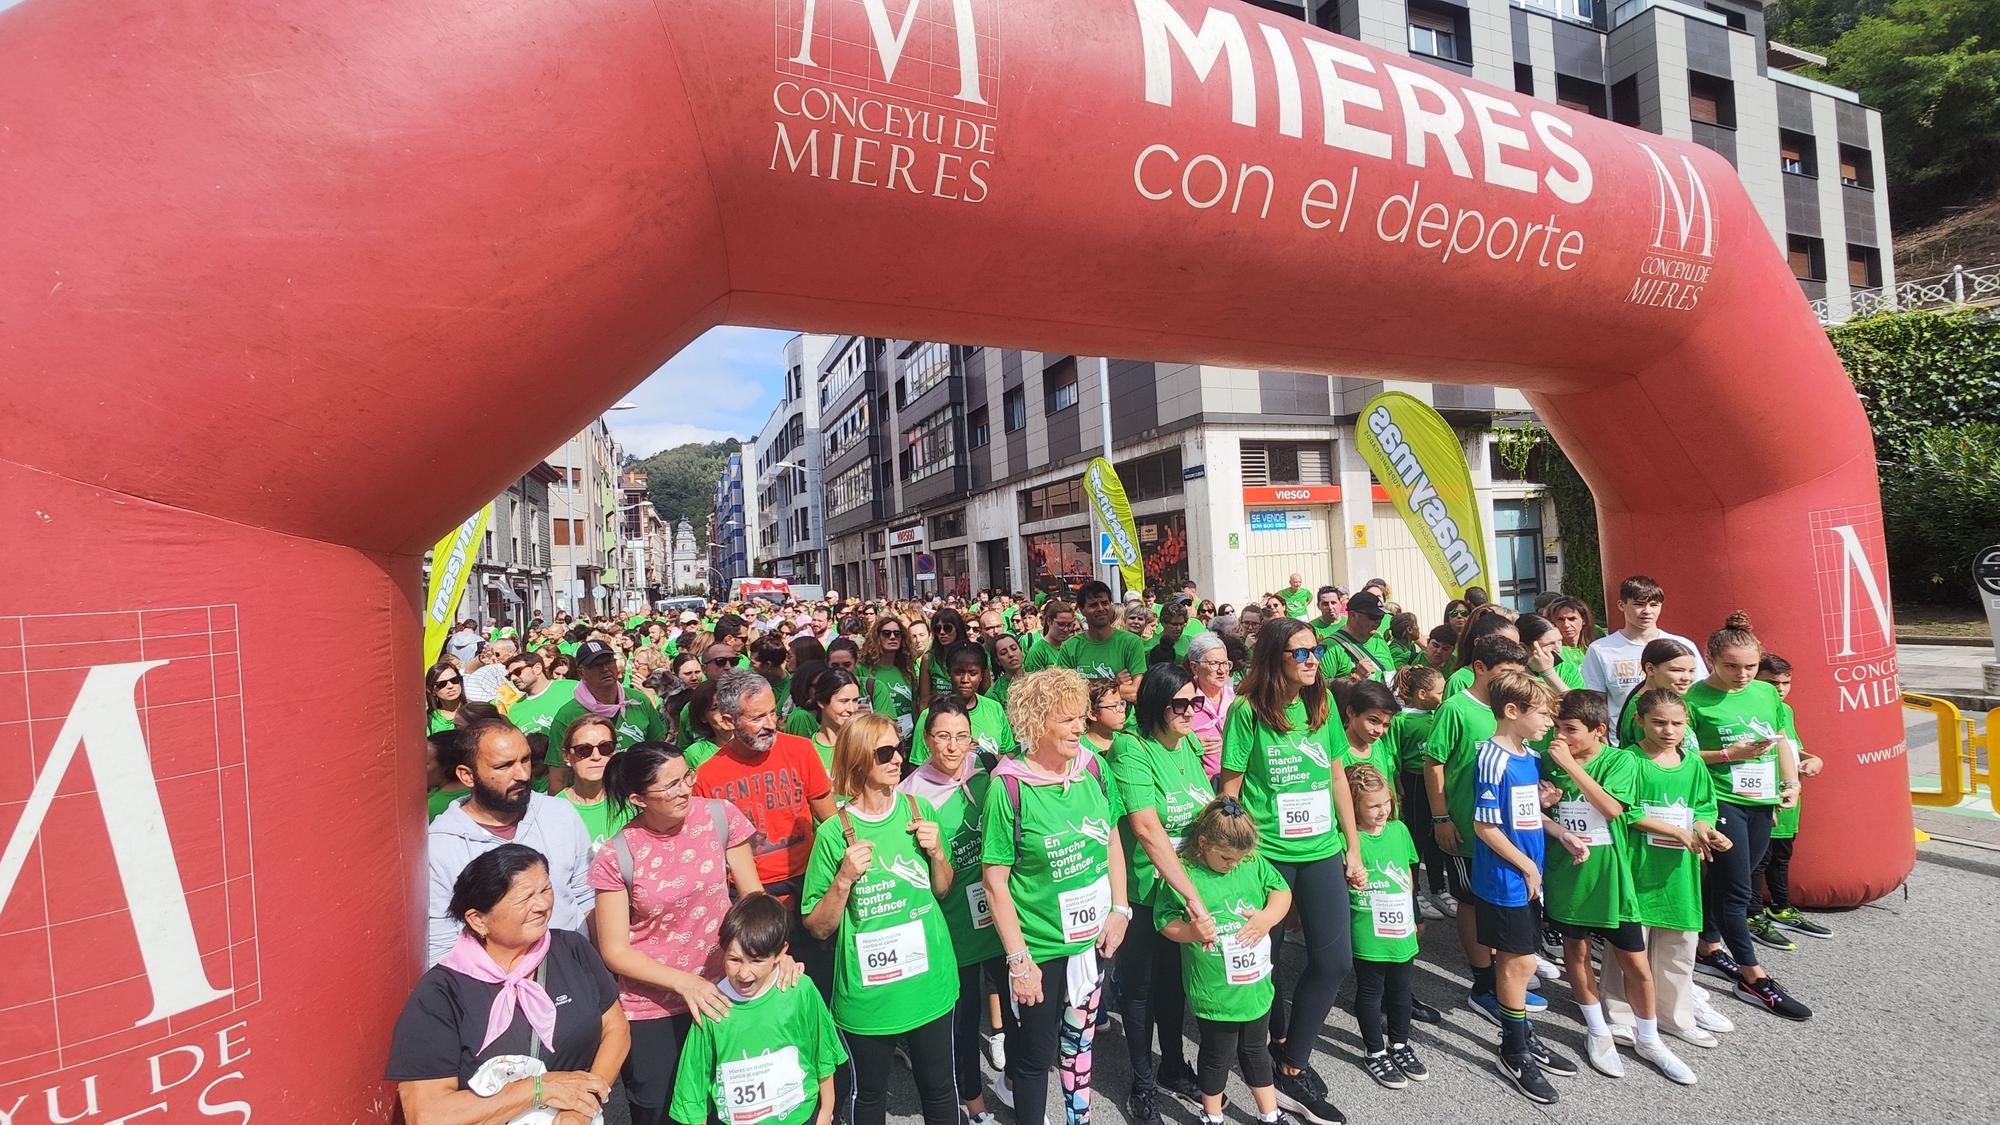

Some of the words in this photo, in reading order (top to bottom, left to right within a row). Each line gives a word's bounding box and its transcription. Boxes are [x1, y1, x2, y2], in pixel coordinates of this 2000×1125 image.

[1133, 0, 1594, 204] MIERES
[773, 82, 943, 144] CONCEYU
[954, 118, 996, 155] DE
[768, 121, 990, 203] MIERES
[1133, 144, 1275, 219] con
[1300, 166, 1358, 233] el
[1376, 180, 1584, 271] deporte
[1640, 256, 1696, 281] CONCEYU
[1694, 266, 1712, 283] DE
[1624, 277, 1703, 311] MIERES
[1251, 514, 1261, 523] SE
[1262, 513, 1285, 522] VENDE
[1718, 727, 1732, 735] En
[1720, 732, 1755, 741] marcha
[1267, 748, 1281, 756] En
[1268, 755, 1302, 765] marcha
[1269, 765, 1298, 774] contra
[1270, 775, 1279, 783] el
[1282, 772, 1310, 782] cáncer
[1740, 778, 1761, 788] 585
[1166, 795, 1177, 803] En
[1167, 801, 1194, 812] marcha
[1518, 803, 1534, 816] 337
[1167, 812, 1192, 822] contra
[1286, 810, 1309, 824] 560
[1563, 819, 1587, 831] 319
[1044, 837, 1060, 849] En
[1047, 840, 1086, 859] marcha
[1050, 854, 1082, 868] contra
[1052, 869, 1062, 879] el
[1064, 856, 1094, 876] cáncer
[855, 879, 896, 895] marcha
[857, 891, 892, 906] contra
[859, 907, 868, 917] el
[871, 898, 907, 915] cáncer
[1069, 906, 1097, 926] 708
[1379, 911, 1404, 924] 559
[1215, 921, 1242, 933] archa
[868, 948, 898, 968] 694
[1232, 952, 1256, 969] 562
[147, 1020, 251, 1095] DE
[733, 1081, 766, 1105] 351
